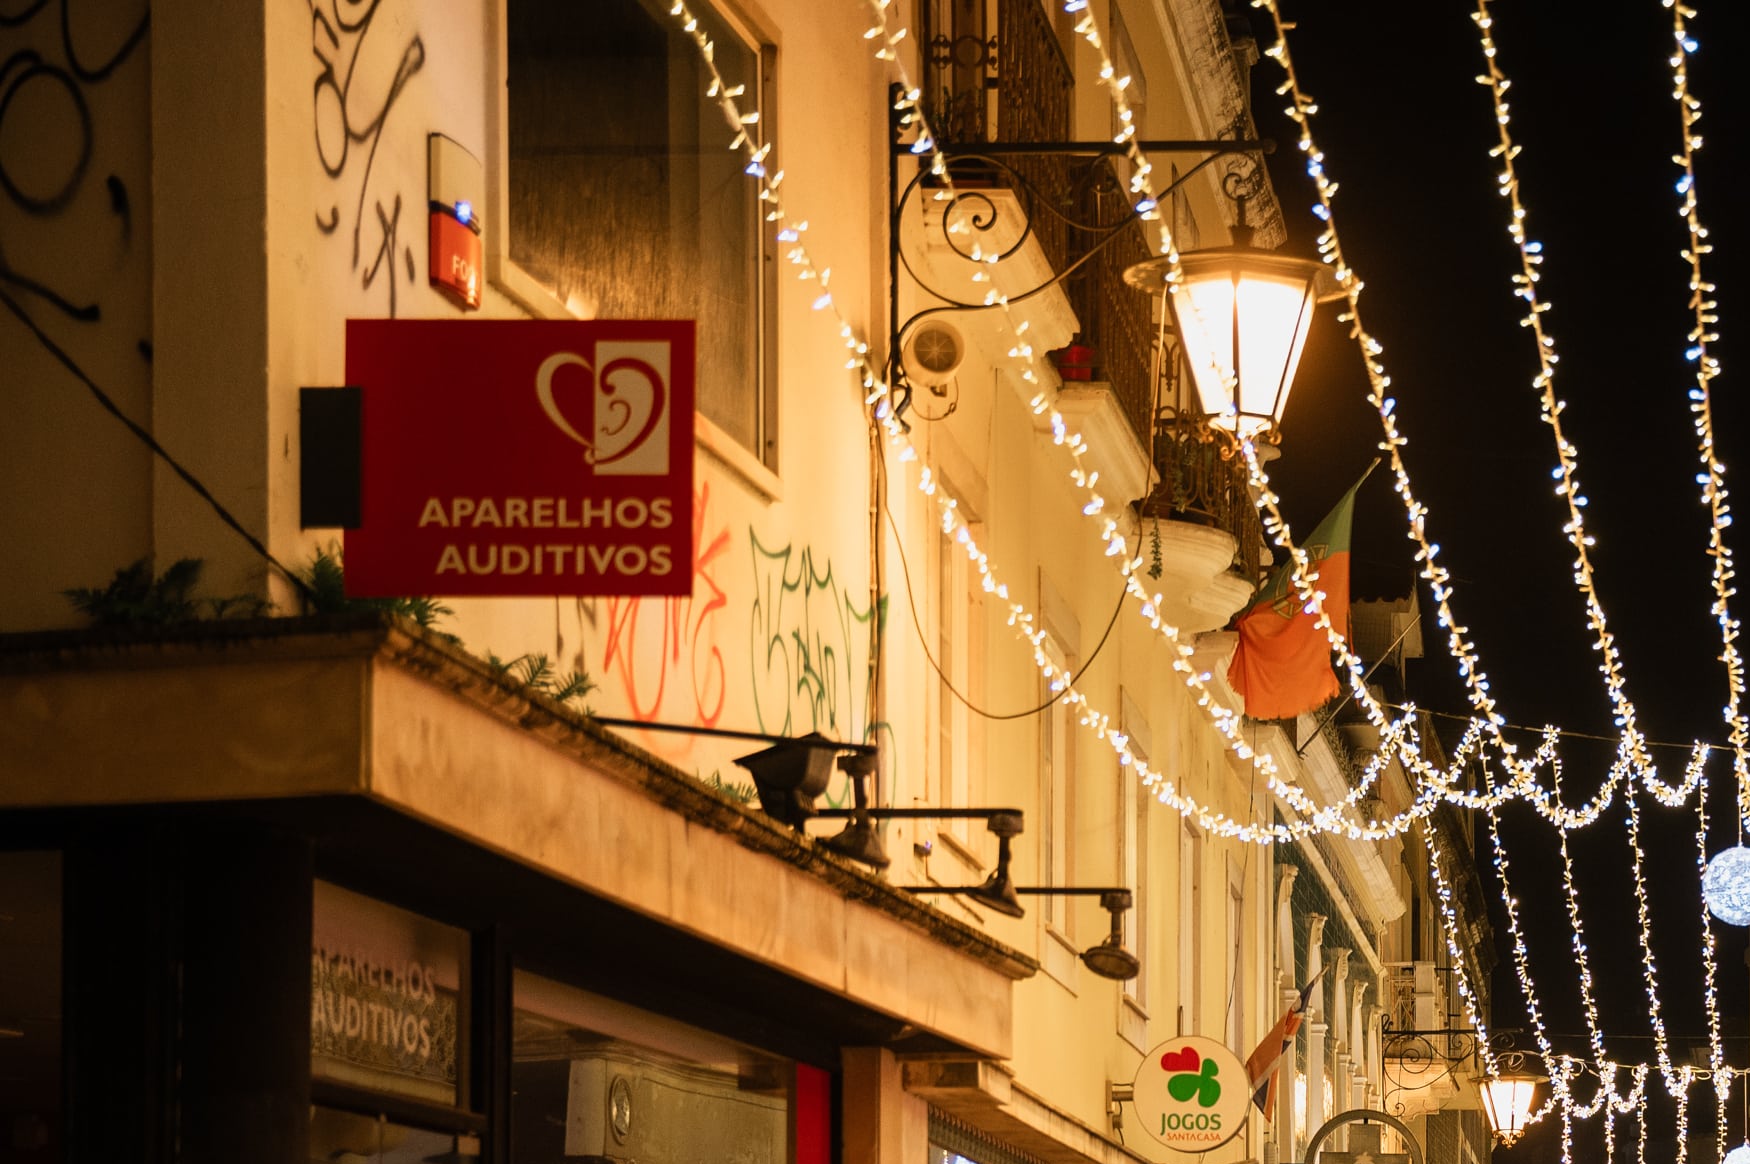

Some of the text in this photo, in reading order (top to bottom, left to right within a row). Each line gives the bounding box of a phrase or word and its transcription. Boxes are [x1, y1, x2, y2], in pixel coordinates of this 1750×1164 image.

[418, 497, 673, 529] APARELHOS
[435, 544, 673, 576] AUDITIVOS
[312, 988, 431, 1058] AUDITIVOS
[1160, 1113, 1222, 1136] JOGOS
